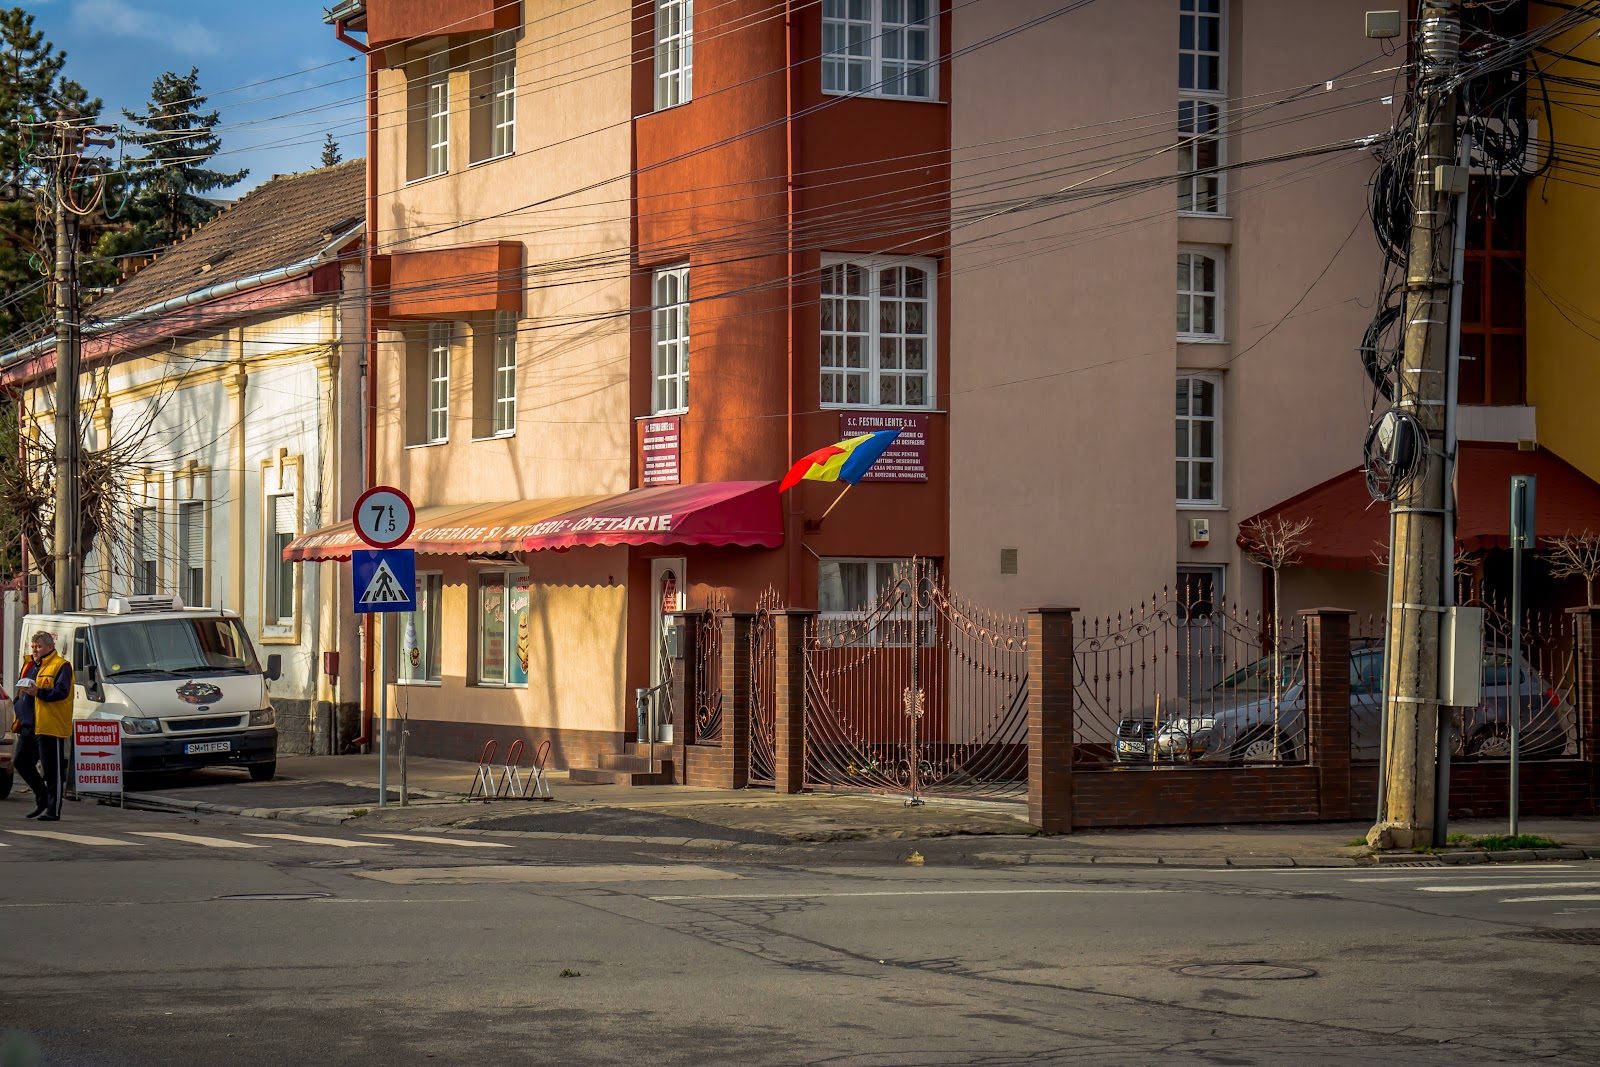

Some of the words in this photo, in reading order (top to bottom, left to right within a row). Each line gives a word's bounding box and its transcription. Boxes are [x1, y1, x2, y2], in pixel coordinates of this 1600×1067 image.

[859, 417, 884, 427] FESTINA
[884, 418, 903, 427] LENTE
[77, 724, 88, 732] Nu
[211, 742, 229, 751] FES
[76, 762, 120, 771] LABORATOR
[78, 774, 119, 784] COFETĂRIE
